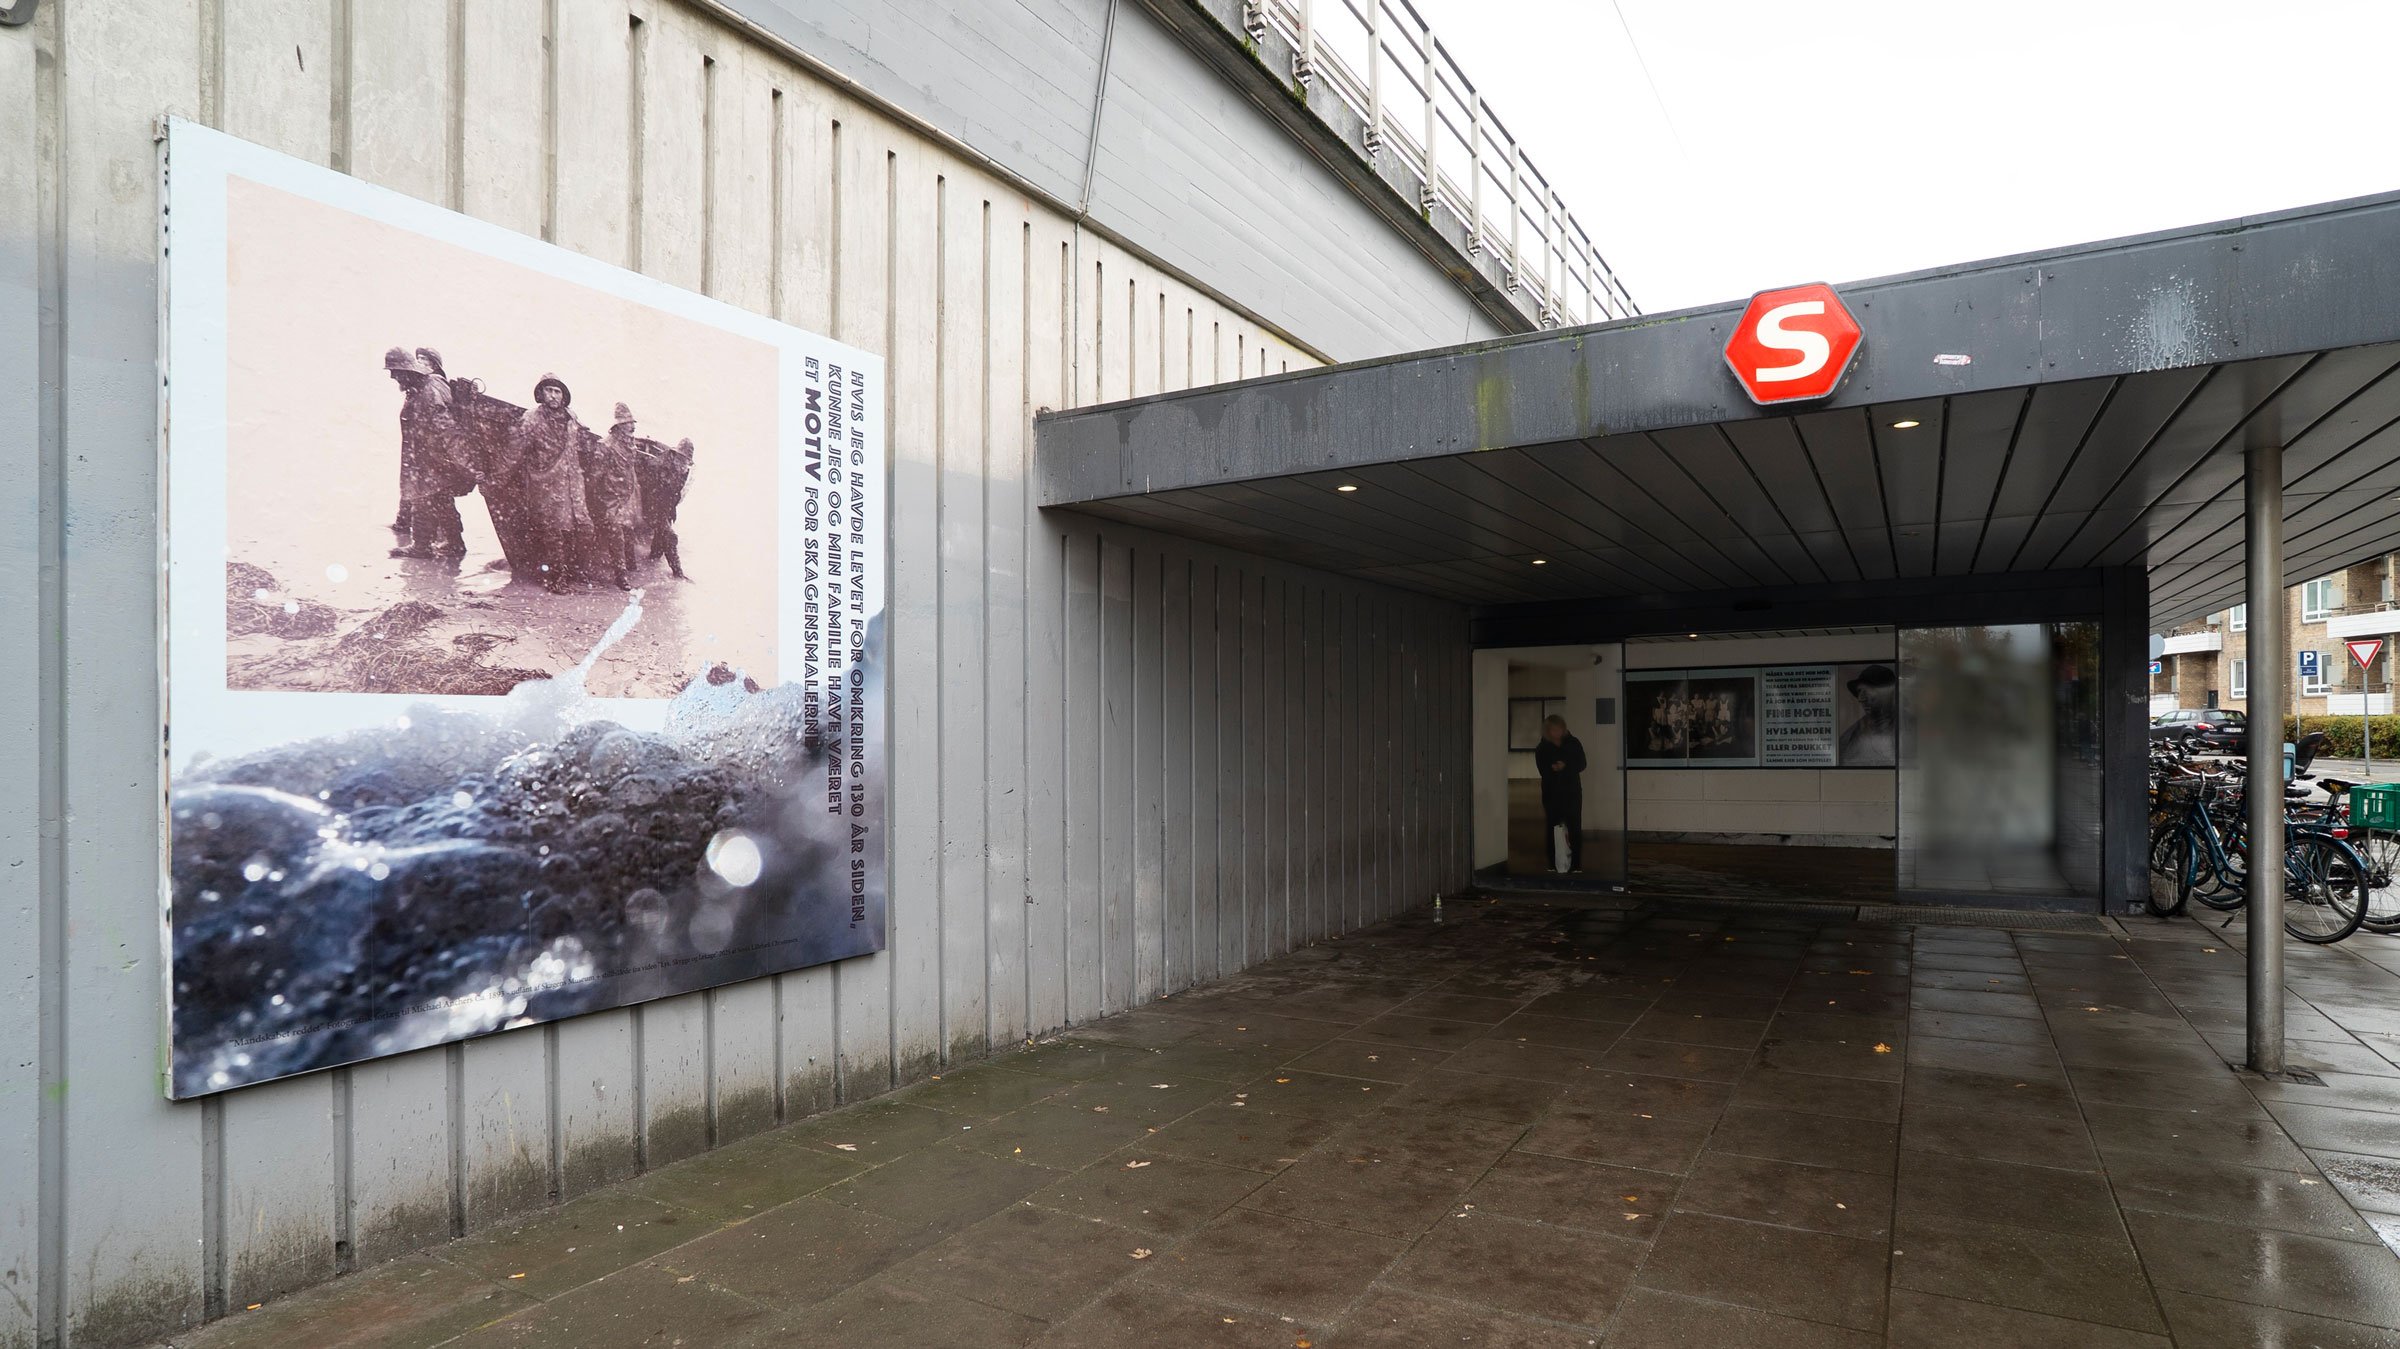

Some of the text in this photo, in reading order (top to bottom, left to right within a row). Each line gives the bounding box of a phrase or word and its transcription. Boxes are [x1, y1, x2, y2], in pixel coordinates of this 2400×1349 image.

[1756, 301, 1830, 382] S
[805, 356, 821, 747] ET MOTIV FOR SKAGENSMALERNE
[828, 363, 841, 815] KUNNE JEG OG MIN FAMILIE HAVE VÆRET
[850, 371, 868, 929] HVIS JEG HAVDE LEVET FOR OMKRING 130 ÅR SIDEN,
[2304, 653, 2314, 665] P
[1766, 708, 1832, 718] FINE HOTEL
[1766, 727, 1832, 735] HVIS MANDEN
[411, 1002, 441, 1015] Michael
